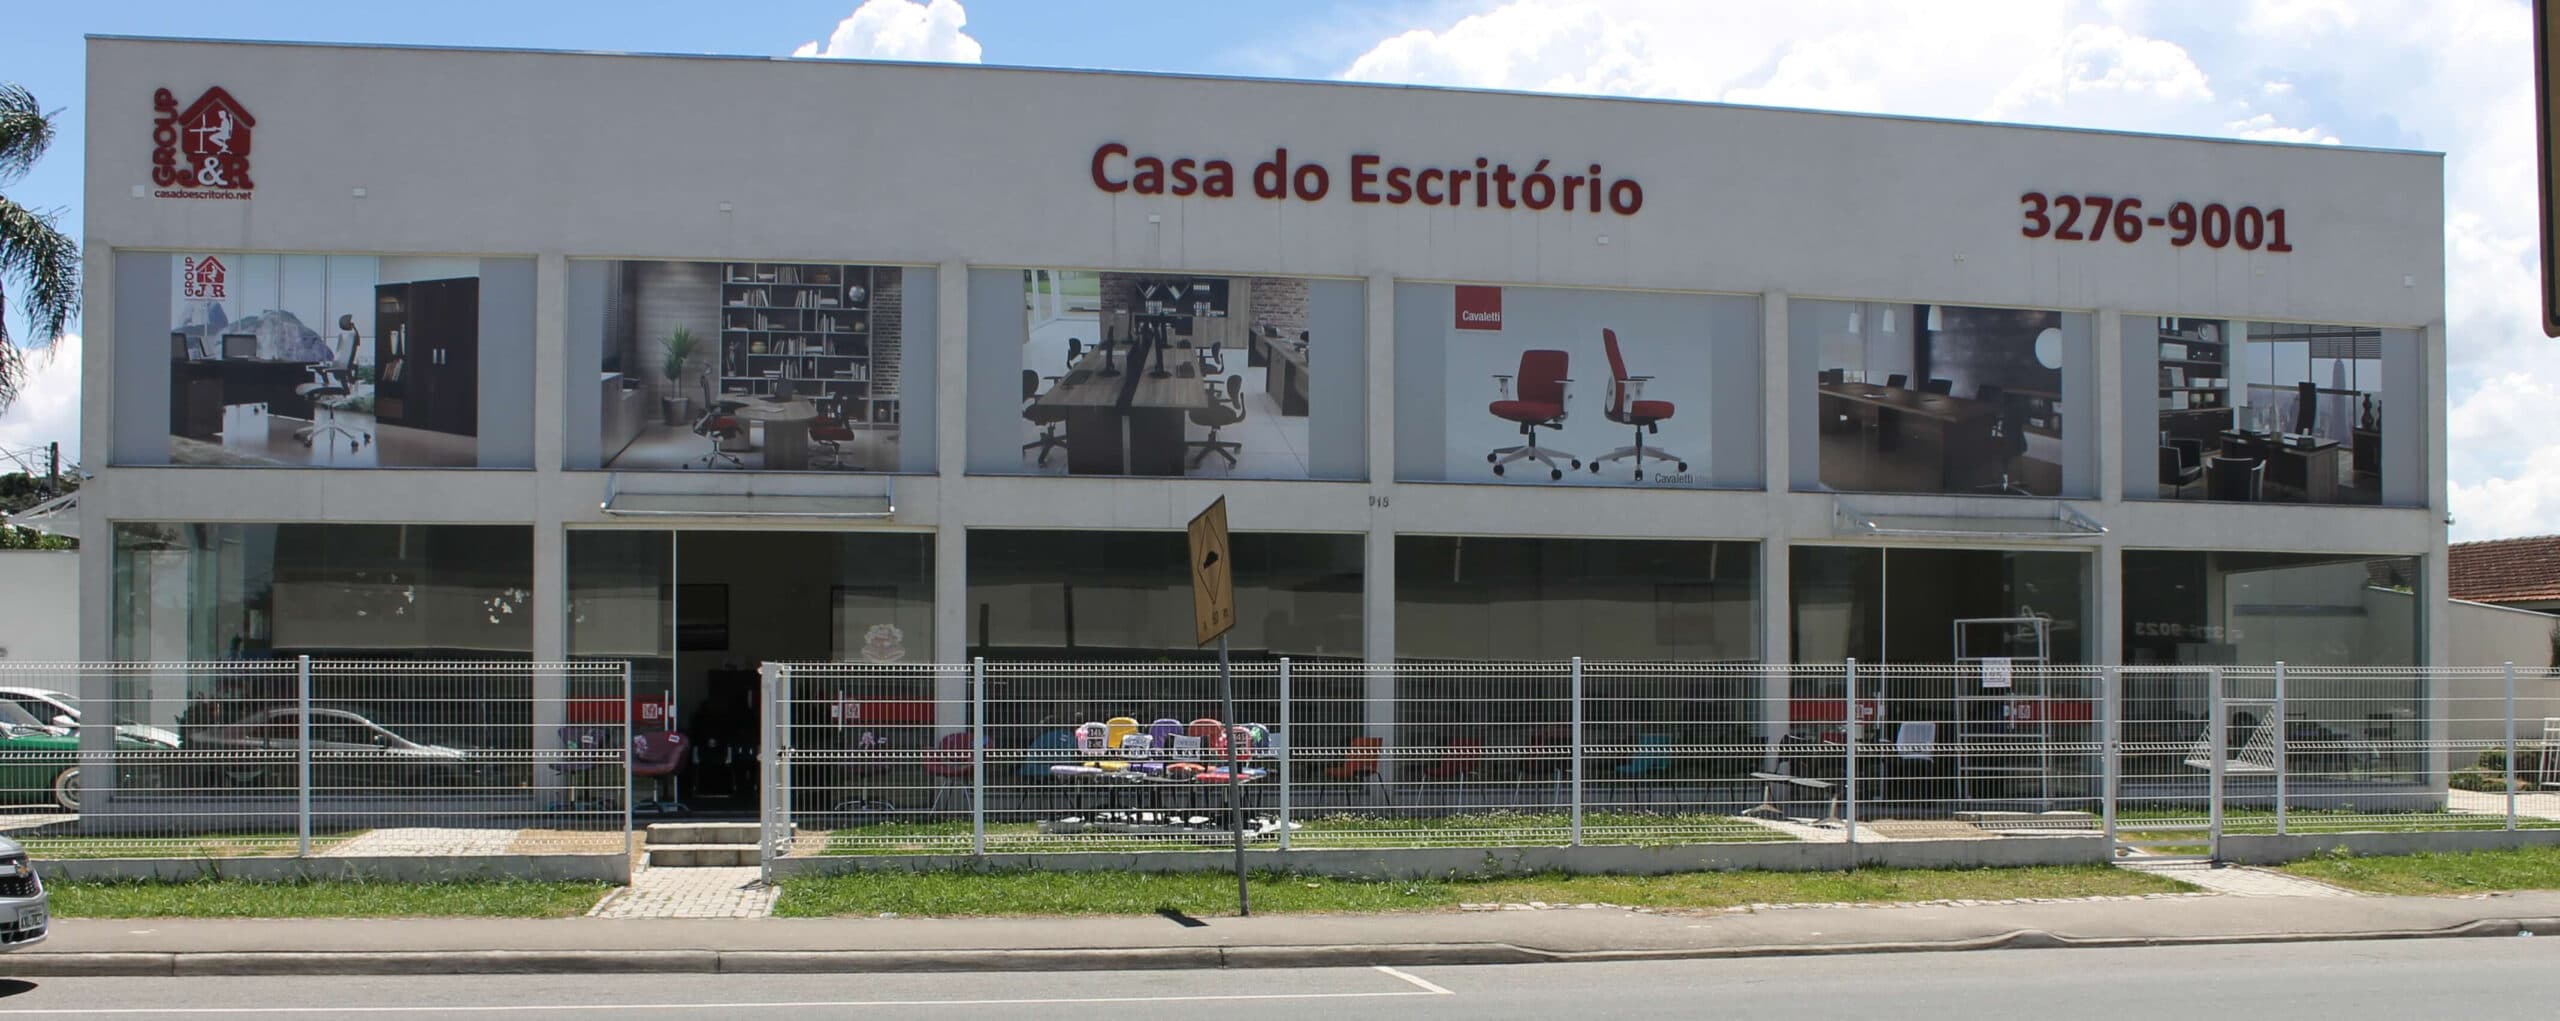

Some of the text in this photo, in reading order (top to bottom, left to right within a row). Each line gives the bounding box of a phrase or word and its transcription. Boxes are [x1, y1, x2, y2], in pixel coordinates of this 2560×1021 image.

[152, 87, 178, 187] GROUP
[154, 189, 252, 200] casadoescritorio.net
[1091, 142, 1644, 216] Casa do Escritório
[2020, 192, 2293, 253] 3276-9001
[184, 256, 195, 297] GROUP
[1462, 310, 1501, 322] Cavaletti
[1655, 472, 1694, 485] Cavaletti
